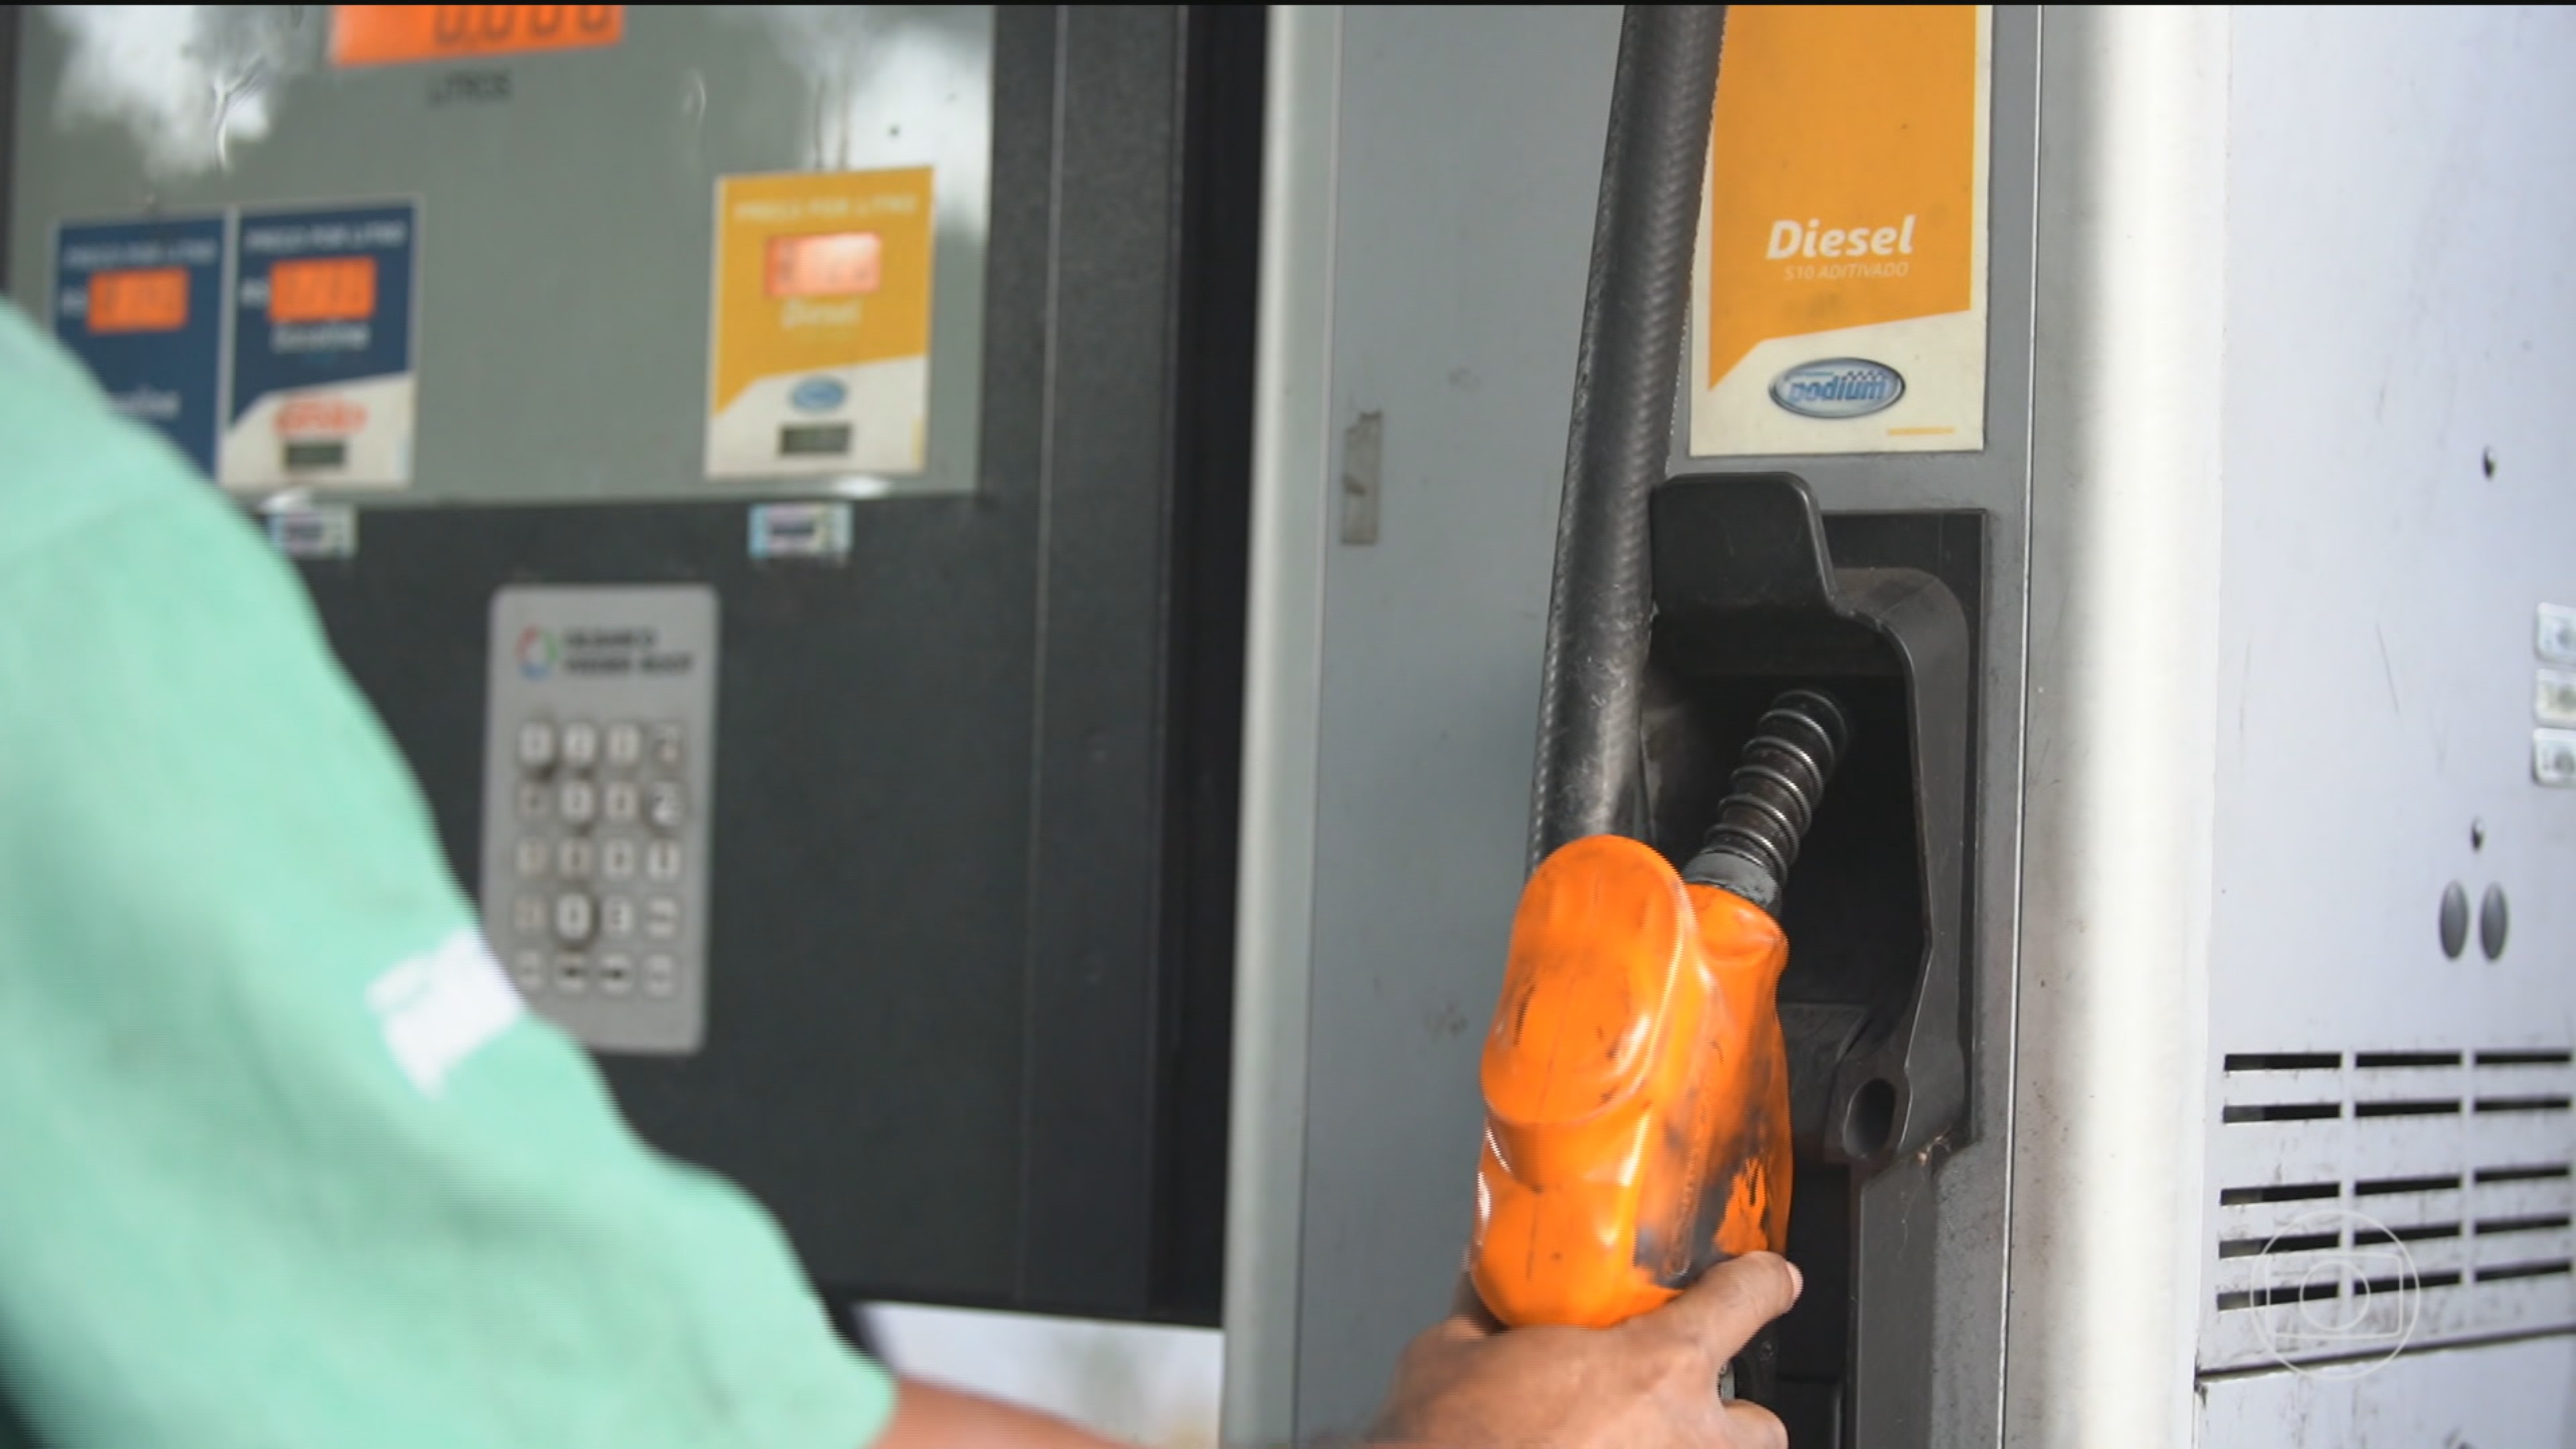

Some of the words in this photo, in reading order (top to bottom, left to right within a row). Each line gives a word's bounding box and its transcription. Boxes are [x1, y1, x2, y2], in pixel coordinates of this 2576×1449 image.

[1766, 214, 1917, 260] Diesel
[1784, 266, 1815, 280] S10
[1817, 261, 1911, 279] ADITIVADO
[1787, 375, 1886, 403] podium
